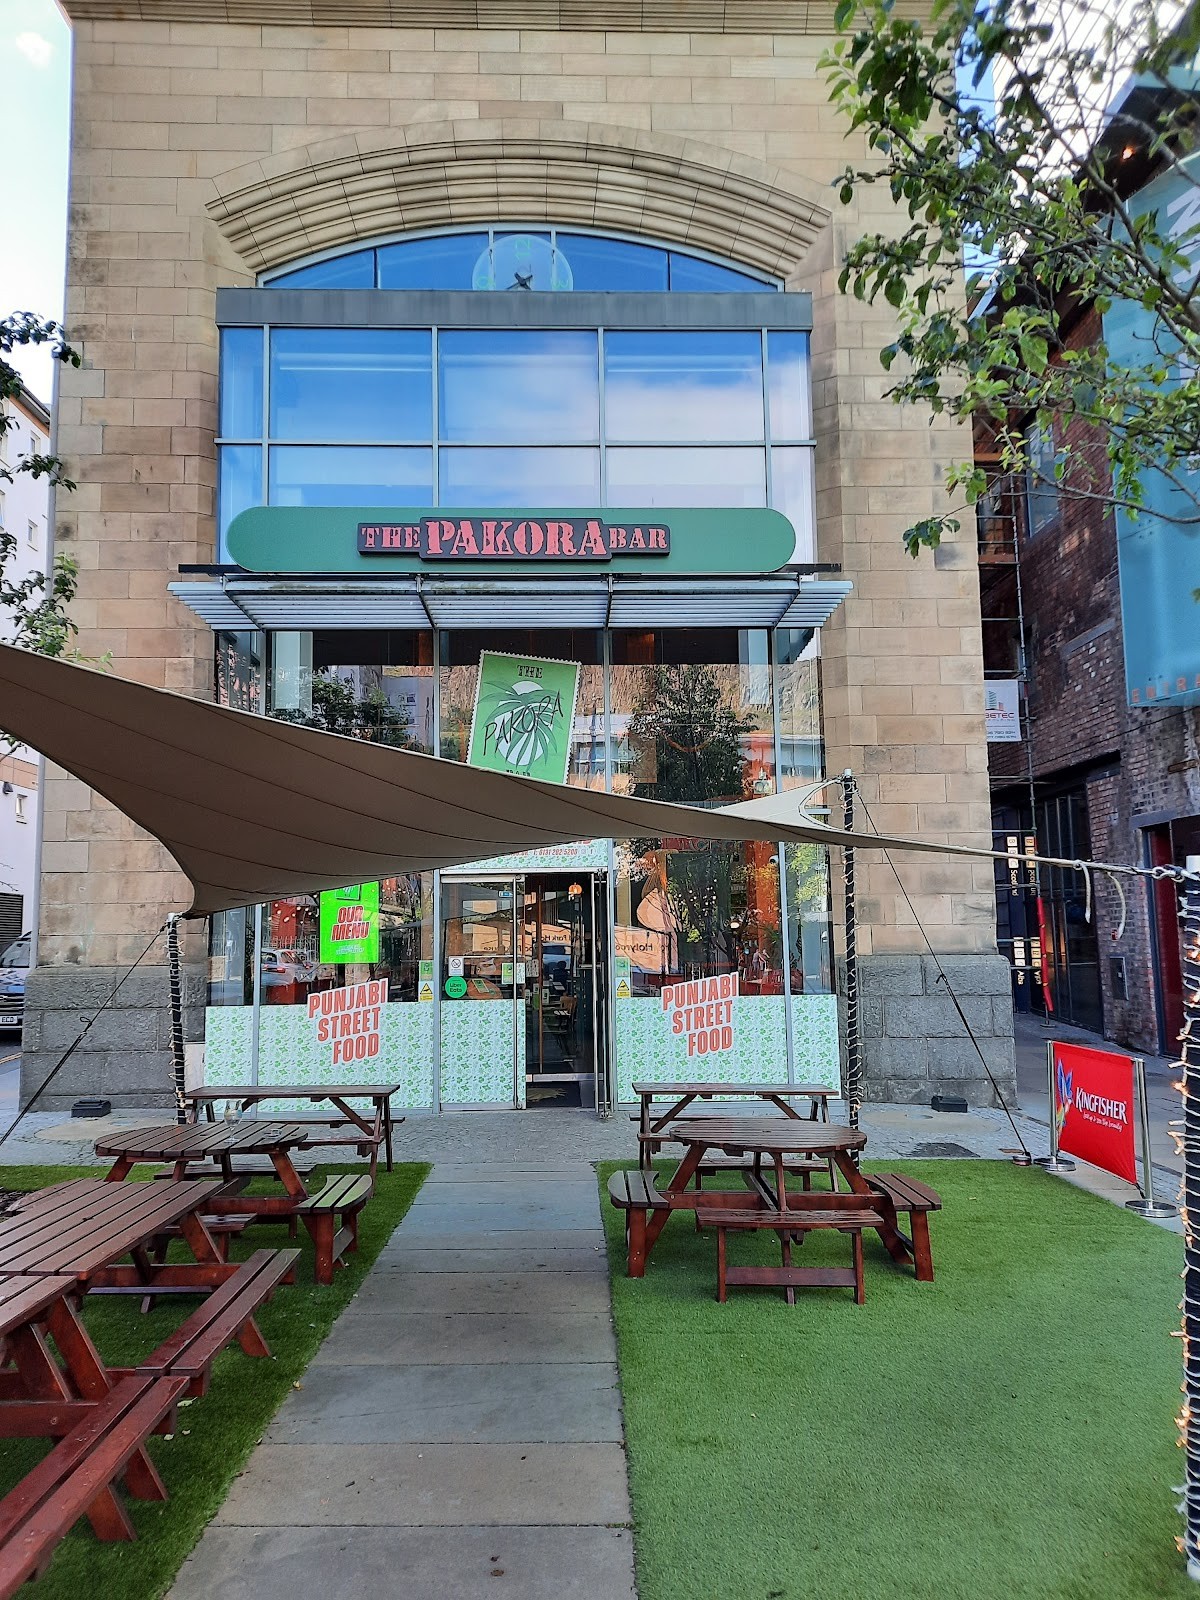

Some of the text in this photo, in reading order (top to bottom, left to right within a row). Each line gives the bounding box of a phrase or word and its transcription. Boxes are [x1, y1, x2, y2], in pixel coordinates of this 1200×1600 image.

[362, 520, 667, 556] THE PAKORA BAR
[517, 665, 543, 678] THE
[483, 690, 564, 756] PAKORA
[338, 905, 364, 923] OUR
[331, 923, 370, 941] MENU
[308, 980, 387, 1019] PUNJABI
[662, 973, 738, 1011] PUNJABI
[318, 1007, 381, 1042] STREET
[672, 1000, 733, 1034] STREET
[333, 1033, 379, 1065] FOOD
[688, 1026, 732, 1057] FOOD
[1076, 1087, 1128, 1124] KINGFISHER
